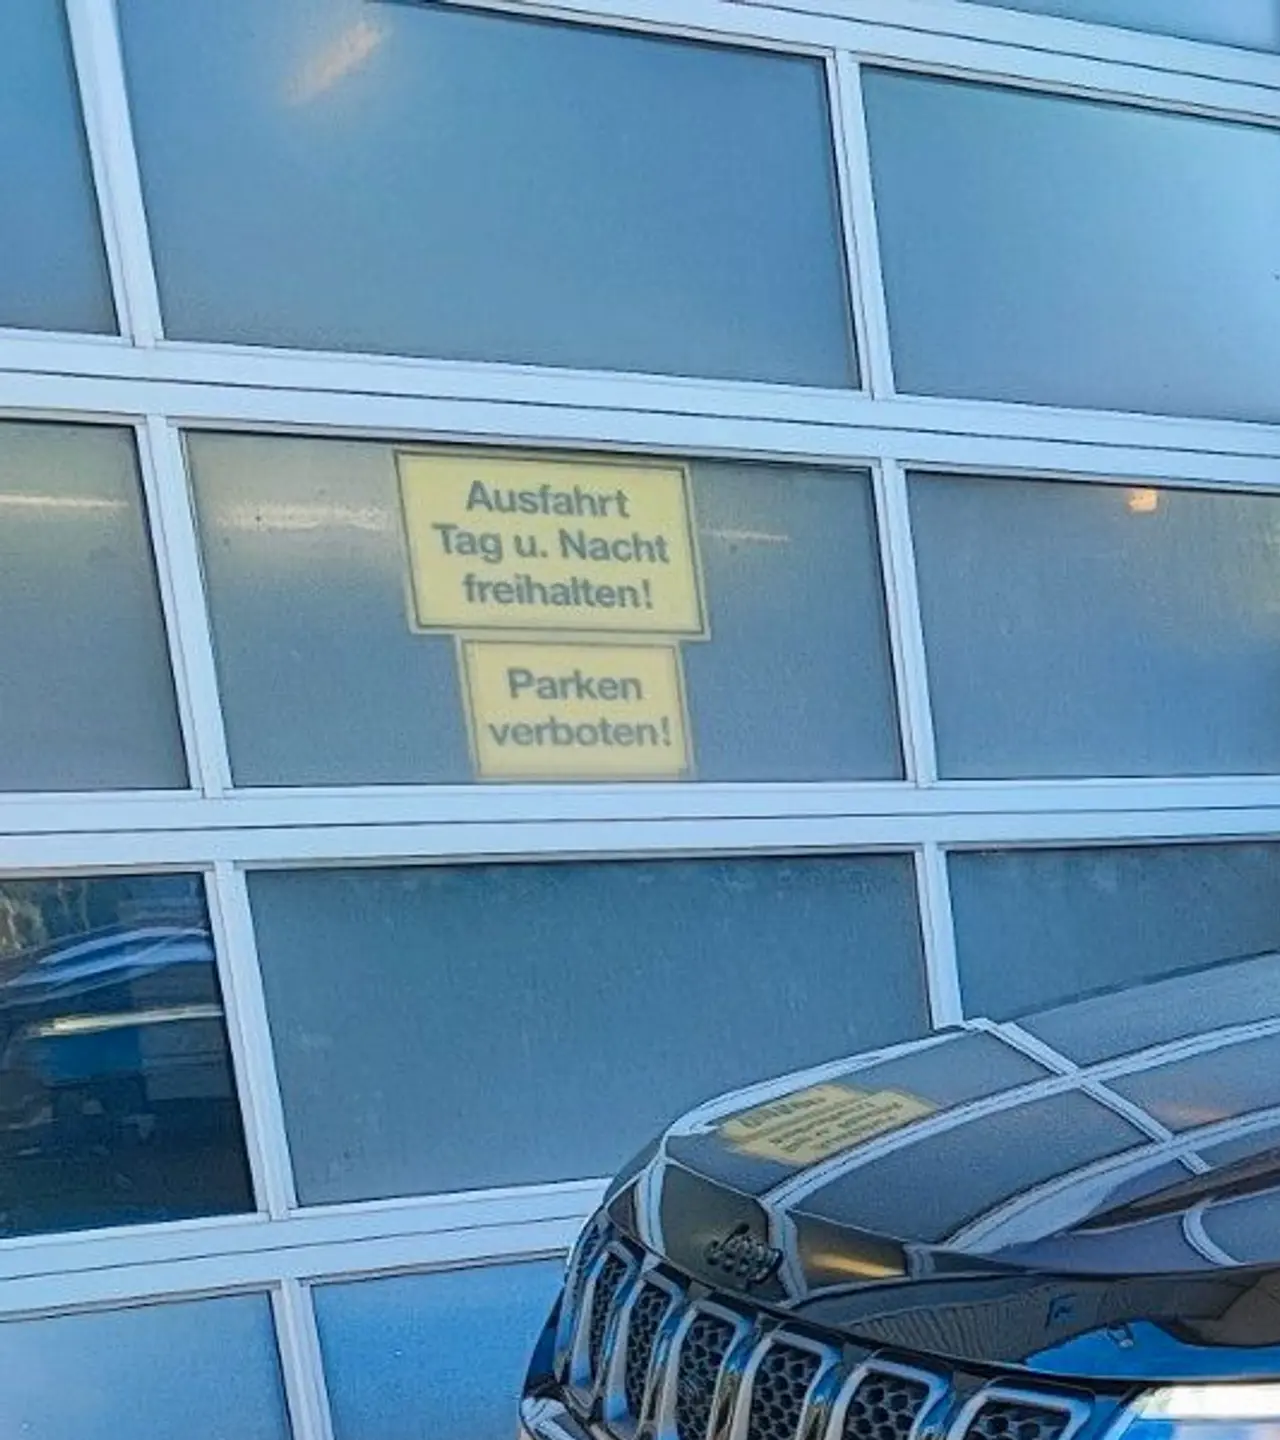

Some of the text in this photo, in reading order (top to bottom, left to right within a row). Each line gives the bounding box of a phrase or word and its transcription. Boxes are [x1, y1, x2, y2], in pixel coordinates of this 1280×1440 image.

[465, 480, 630, 518] Ausfahrt
[432, 522, 670, 564] Tag u. Nacht
[462, 573, 653, 609] freihalten!
[507, 667, 643, 701] Parken
[488, 716, 672, 747] verboten!
